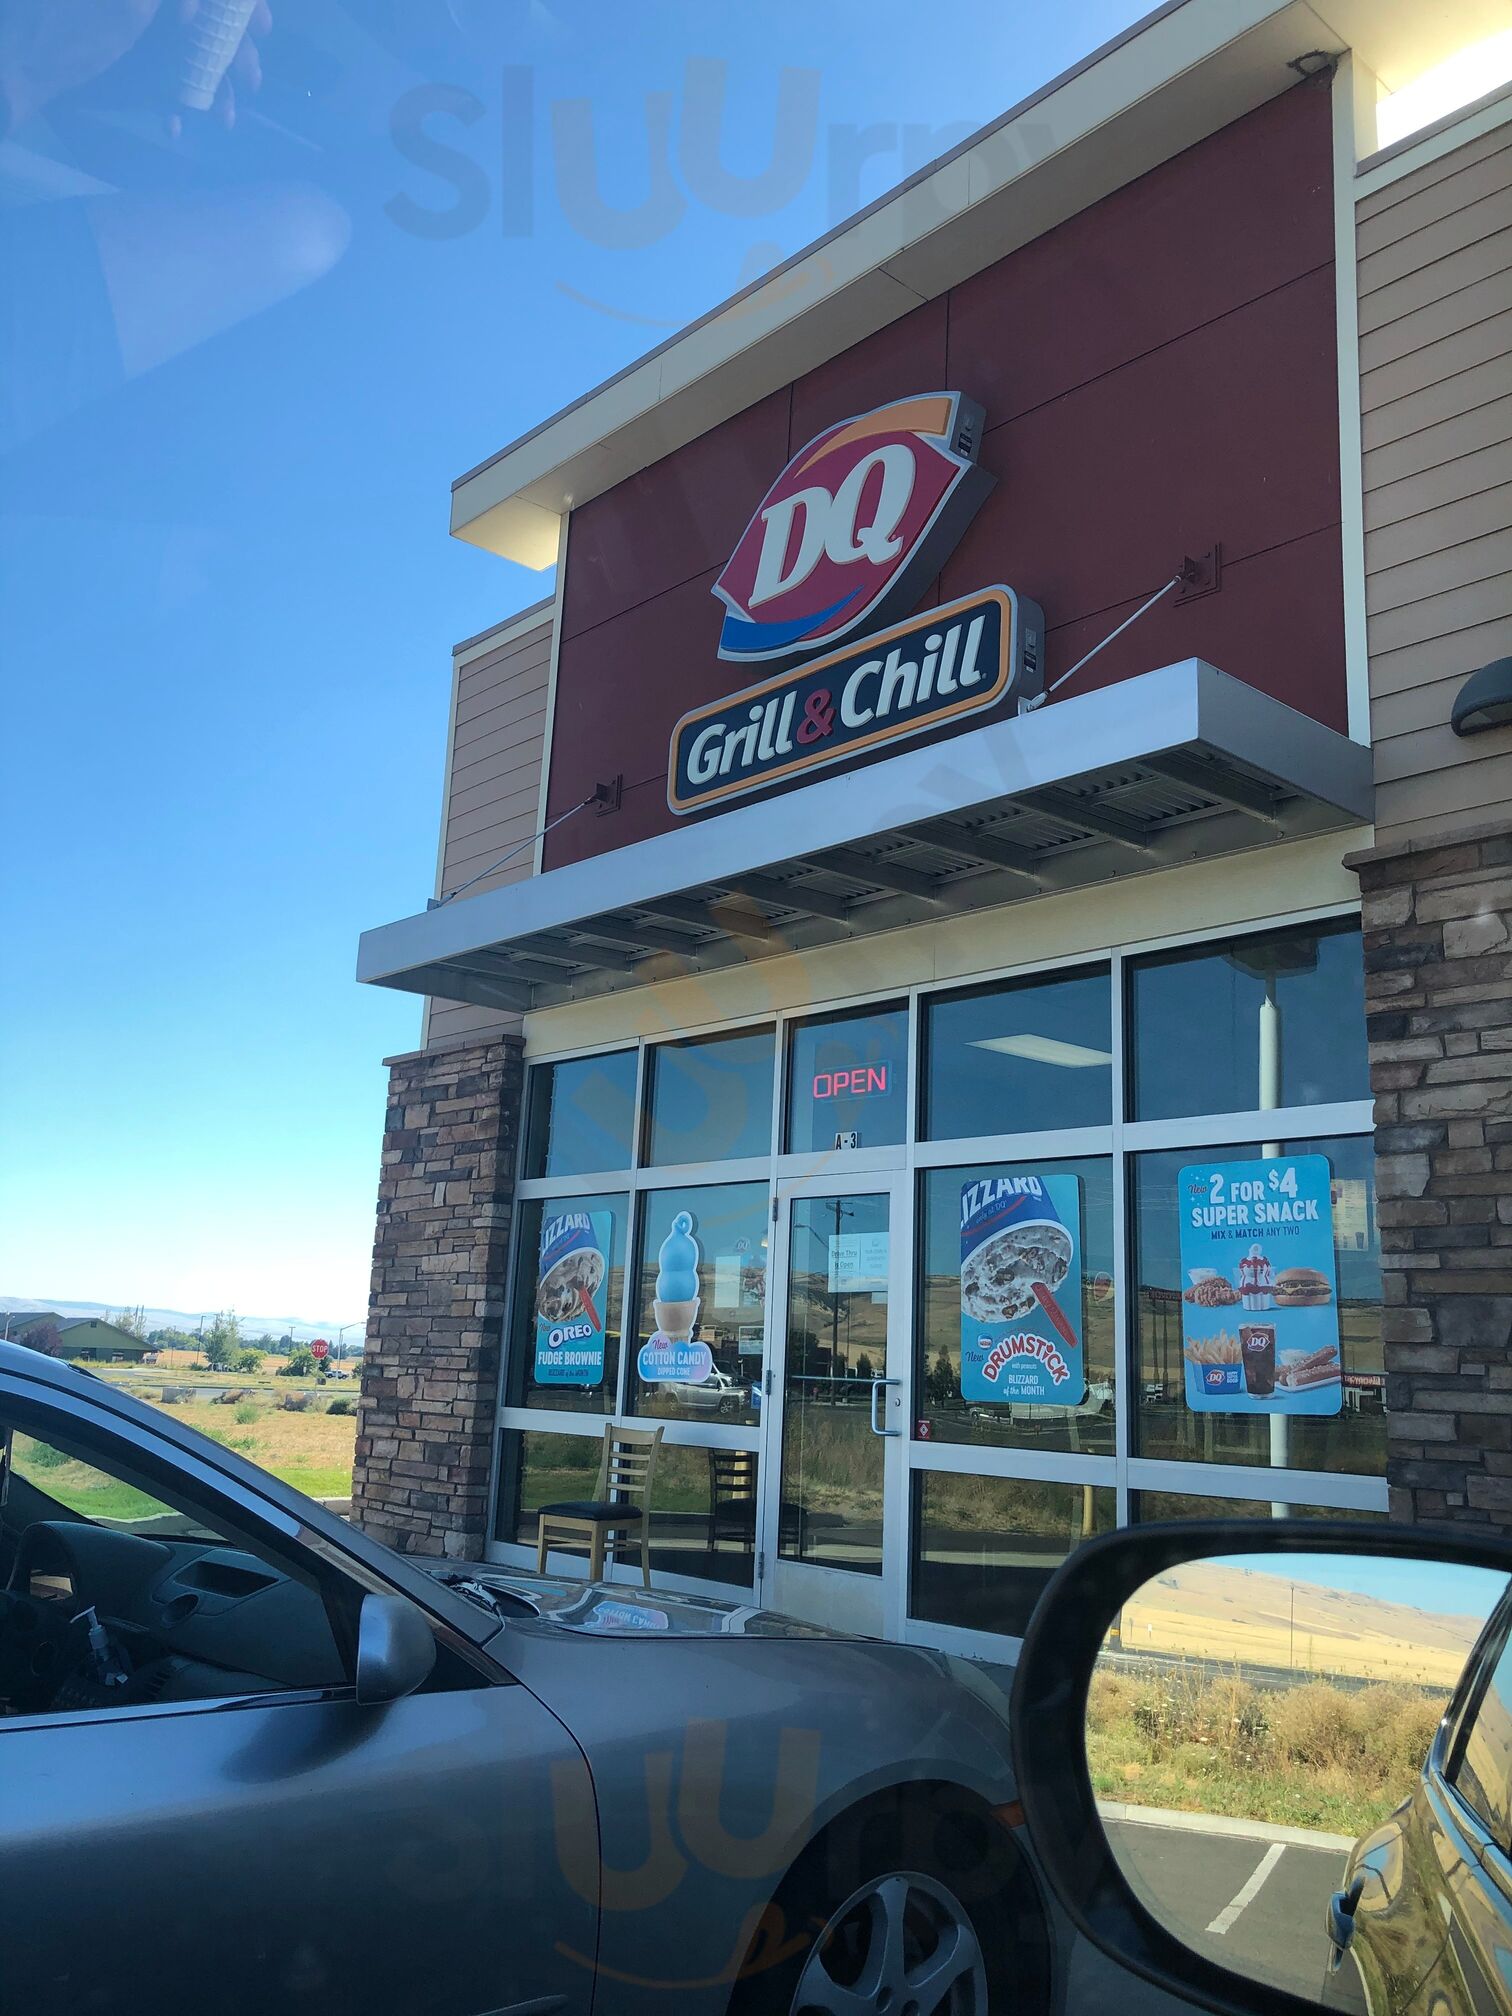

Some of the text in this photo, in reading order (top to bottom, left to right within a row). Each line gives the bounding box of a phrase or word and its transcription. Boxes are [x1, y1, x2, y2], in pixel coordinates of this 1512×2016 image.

[748, 444, 917, 609] DQ
[686, 614, 987, 785] Grill & Chill
[813, 1066, 886, 1099] OPEN
[1209, 1173, 1225, 1204] 2
[1230, 1180, 1265, 1203] FOR
[1268, 1167, 1298, 1199] $4
[961, 1176, 1043, 1228] IZZARD
[1192, 1199, 1319, 1228] SUPER SNACK
[1211, 1226, 1300, 1240] MIX & MATCH ANY TWO
[548, 1324, 593, 1348] OREO
[1250, 1335, 1268, 1348] DQ
[312, 1345, 328, 1353] STOP
[652, 1339, 669, 1350] New
[538, 1351, 602, 1366] FUDGE BROWNIE
[642, 1351, 707, 1366] COTTON CANDY
[965, 1351, 984, 1362] New
[657, 1367, 691, 1376] DIPPED CONE
[1209, 1373, 1222, 1382] DQ
[1008, 1374, 1039, 1385] BLIZZARD
[1021, 1385, 1045, 1396] MONTH
